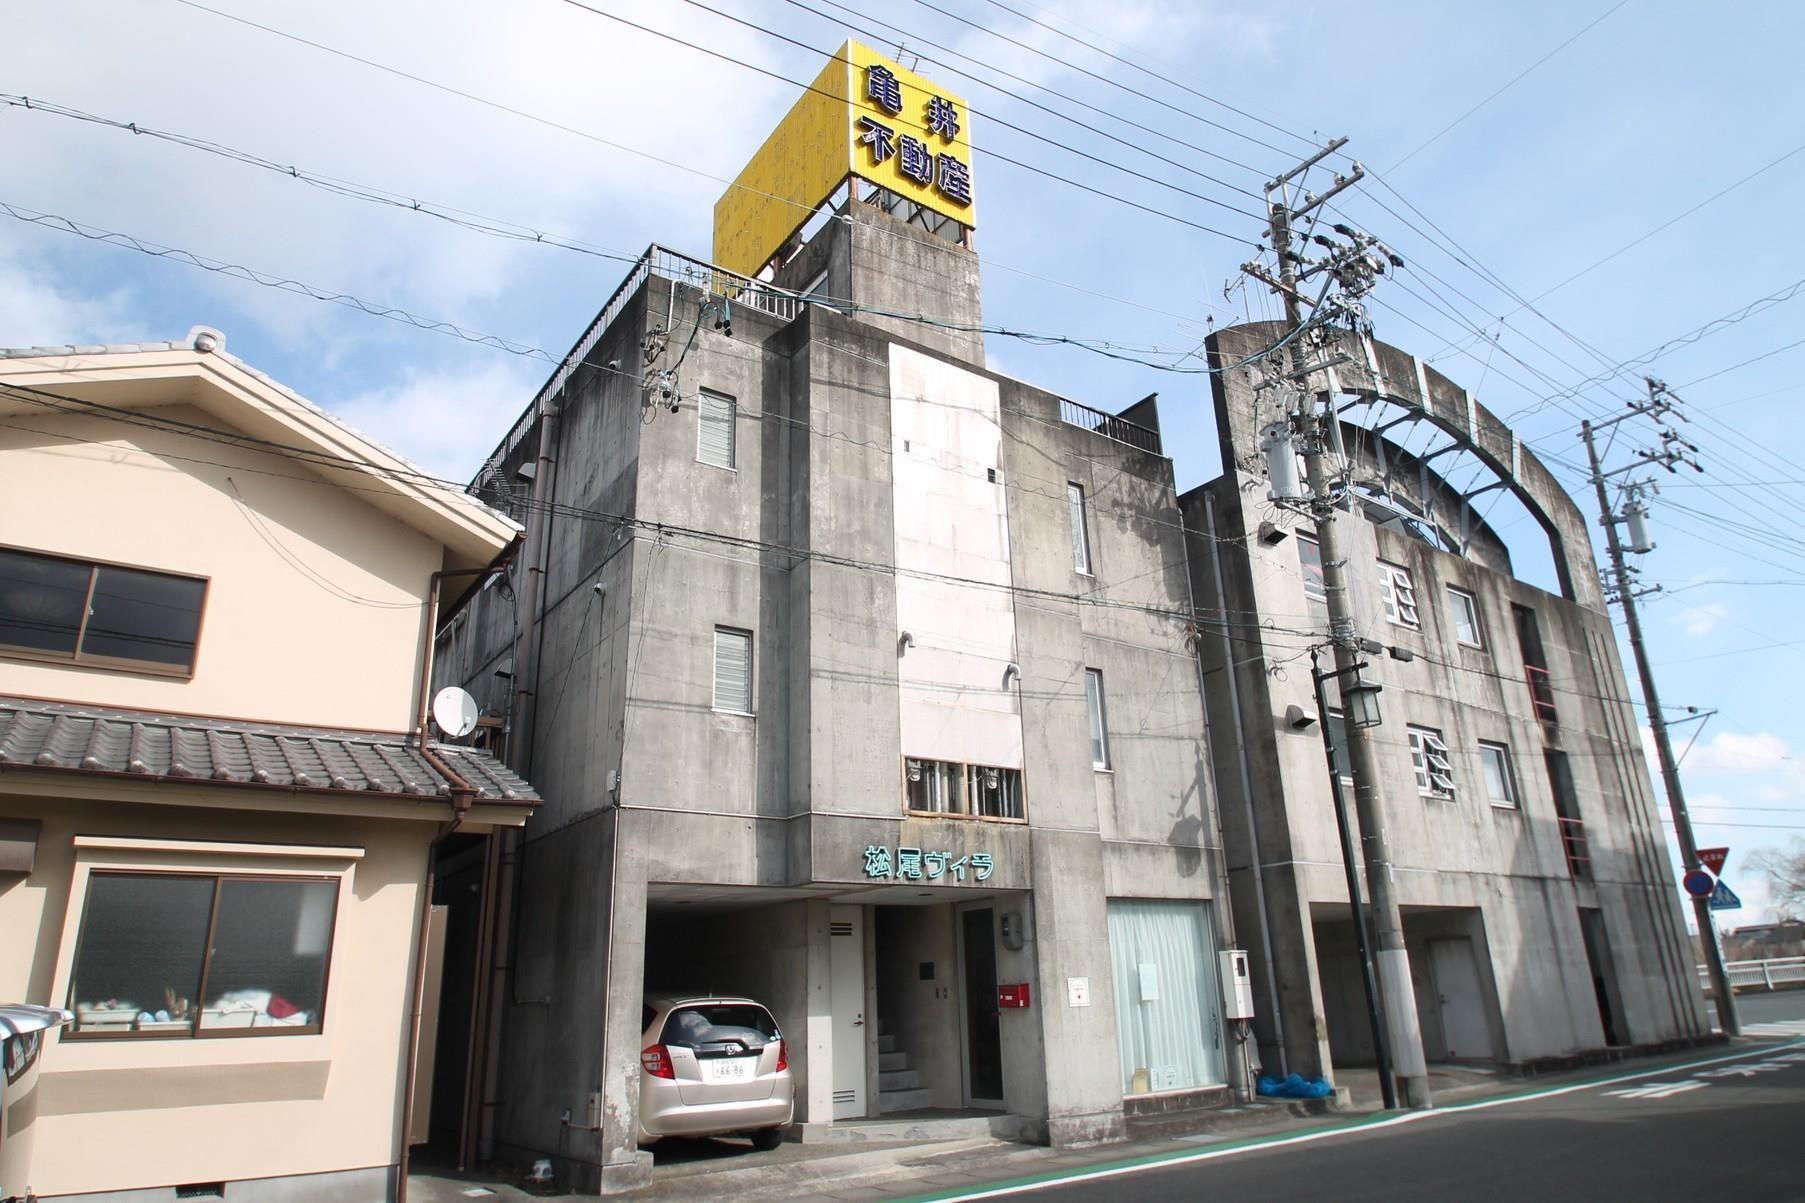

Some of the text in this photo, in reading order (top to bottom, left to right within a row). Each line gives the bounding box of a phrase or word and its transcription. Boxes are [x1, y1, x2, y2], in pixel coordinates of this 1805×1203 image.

[867, 64, 960, 140] 亀井
[859, 115, 972, 206] 不動産
[865, 845, 994, 880] 松尾ヴィラ
